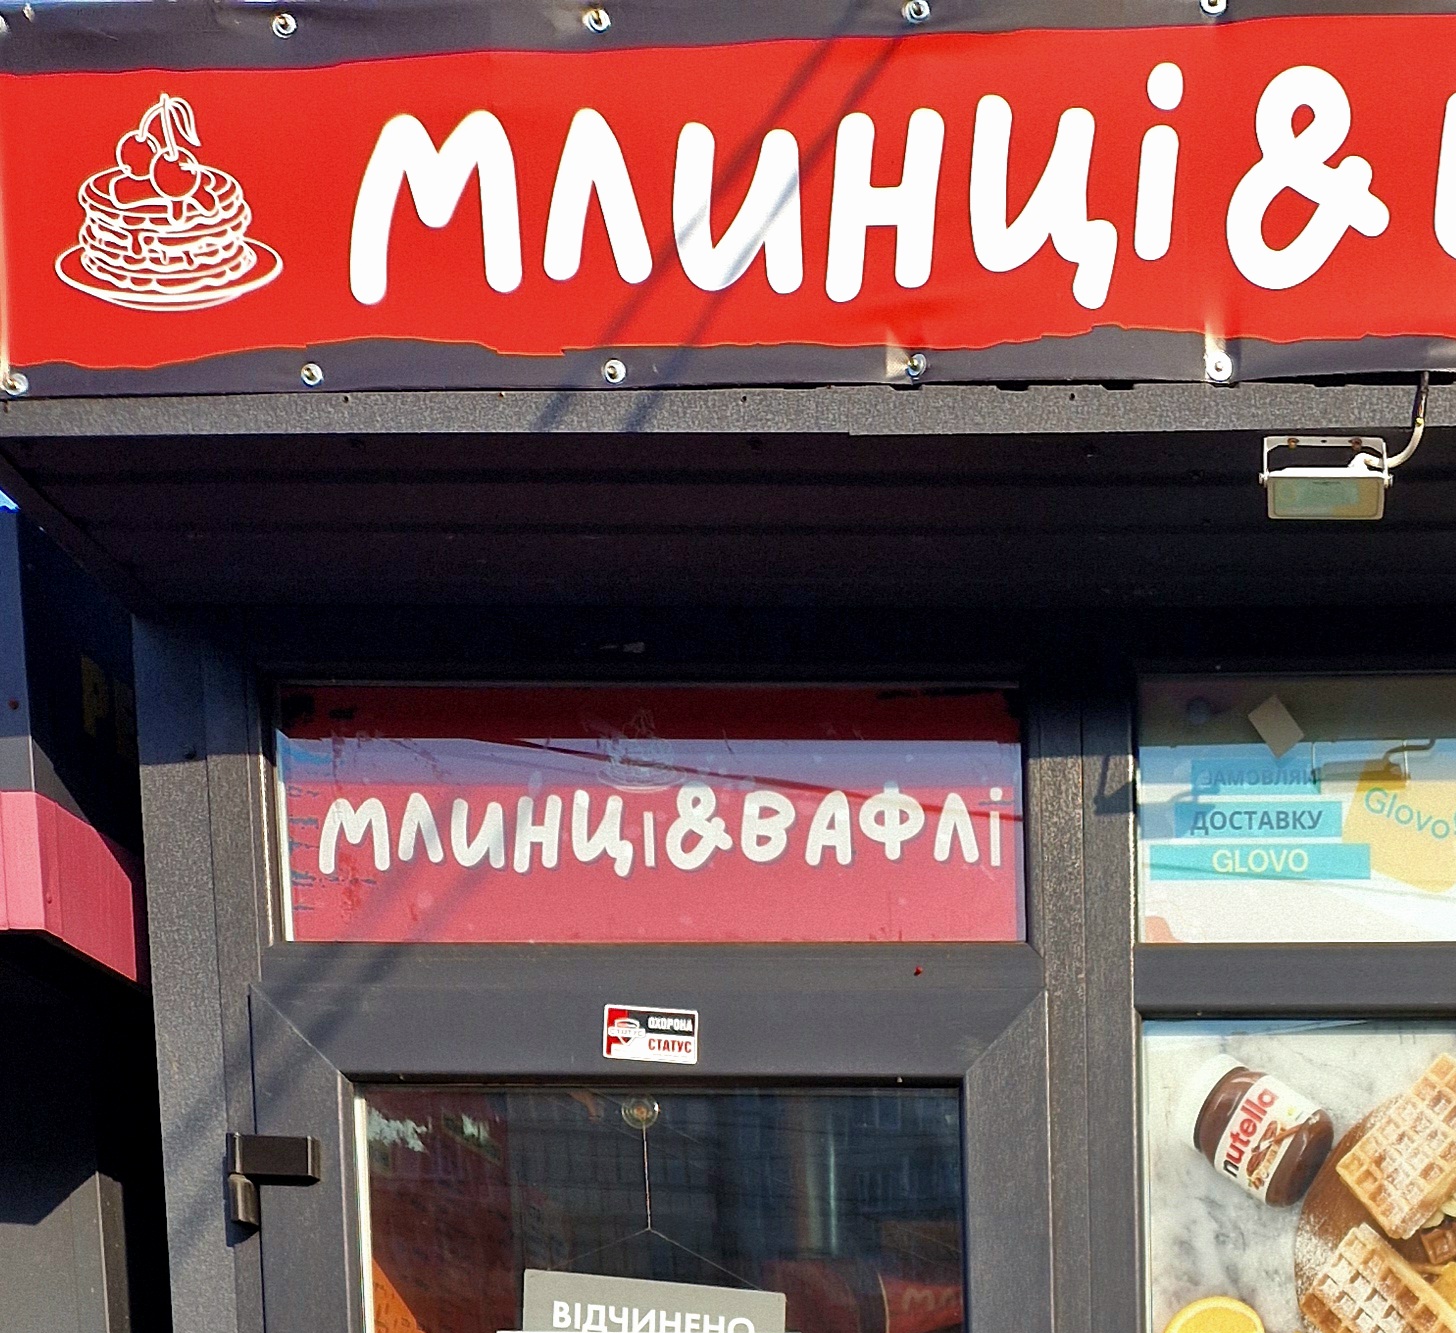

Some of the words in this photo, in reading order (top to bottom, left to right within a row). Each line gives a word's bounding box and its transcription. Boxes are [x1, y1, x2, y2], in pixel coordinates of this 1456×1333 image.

[318, 782, 1004, 877] МЛИНЦІ&ВАФЛІ
[1190, 809, 1323, 835] ДОСТАВКУ
[1212, 849, 1309, 873] GLOVO
[648, 1016, 693, 1032] ОХОРОНА
[648, 1038, 692, 1054] СТАТУС
[1223, 1088, 1279, 1178] nutella
